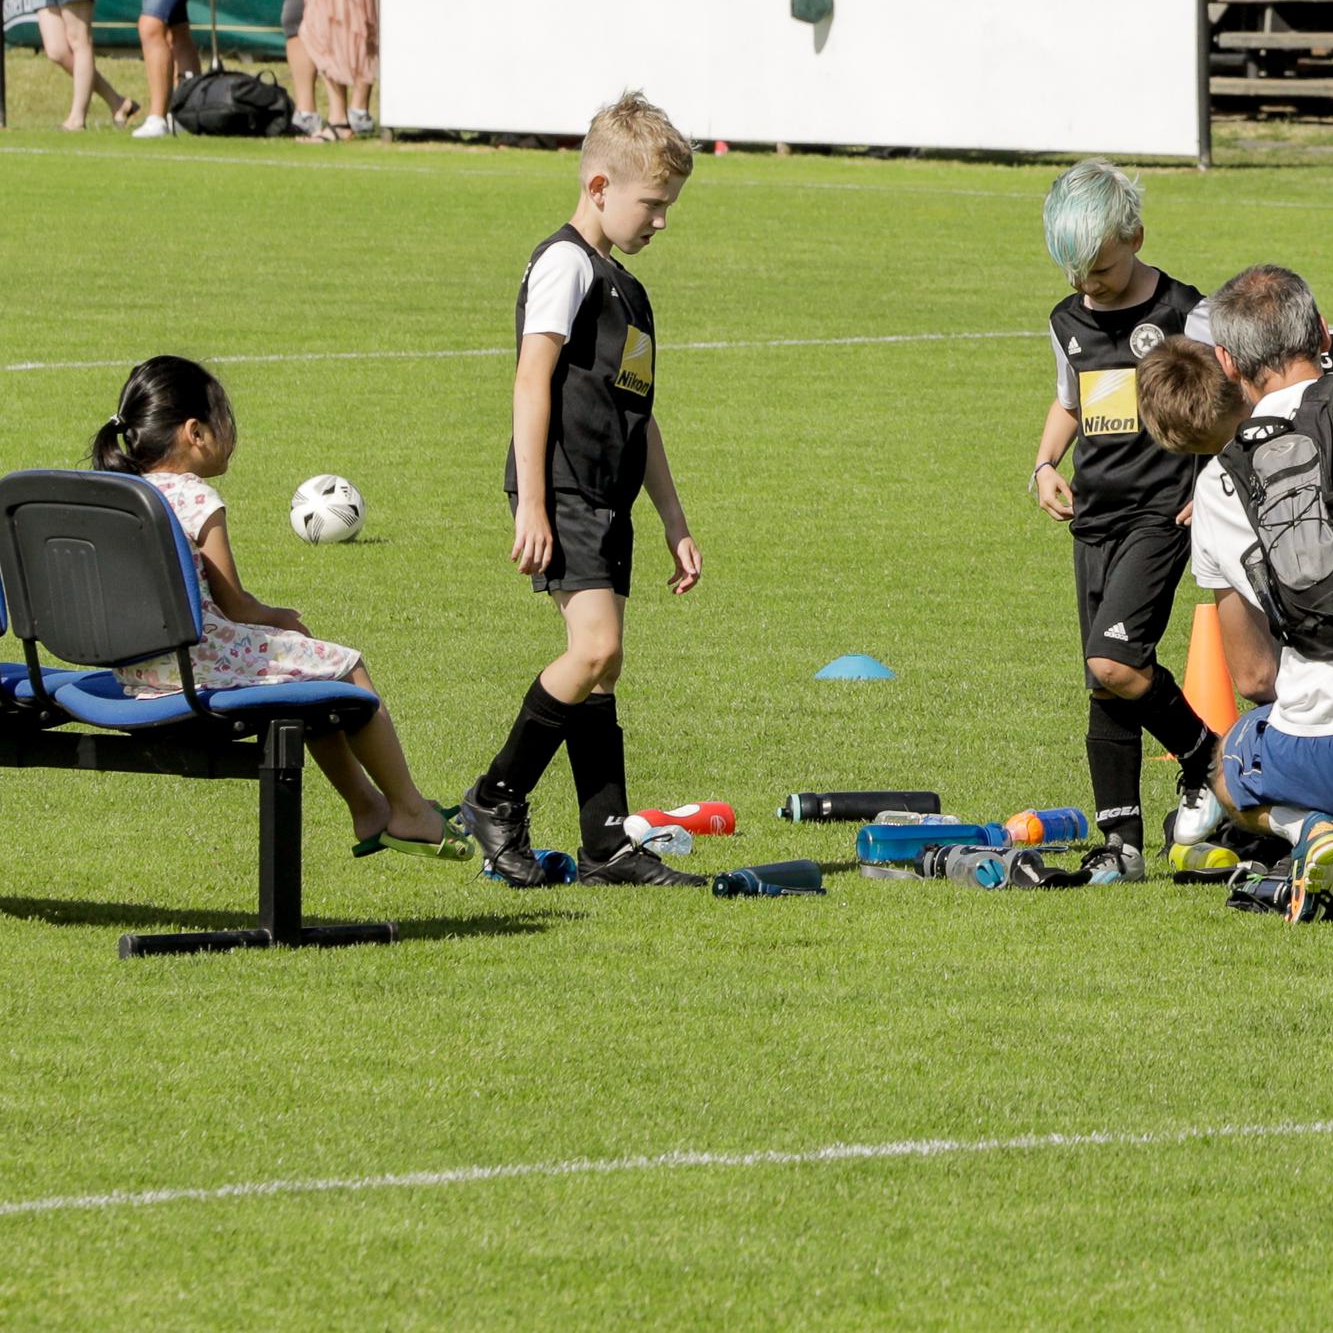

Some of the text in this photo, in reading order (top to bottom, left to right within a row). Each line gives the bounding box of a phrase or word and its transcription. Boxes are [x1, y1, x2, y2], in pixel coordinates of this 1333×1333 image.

[618, 370, 650, 394] Nikon
[1084, 415, 1136, 434] Nikon
[1095, 805, 1140, 822] LEGEA
